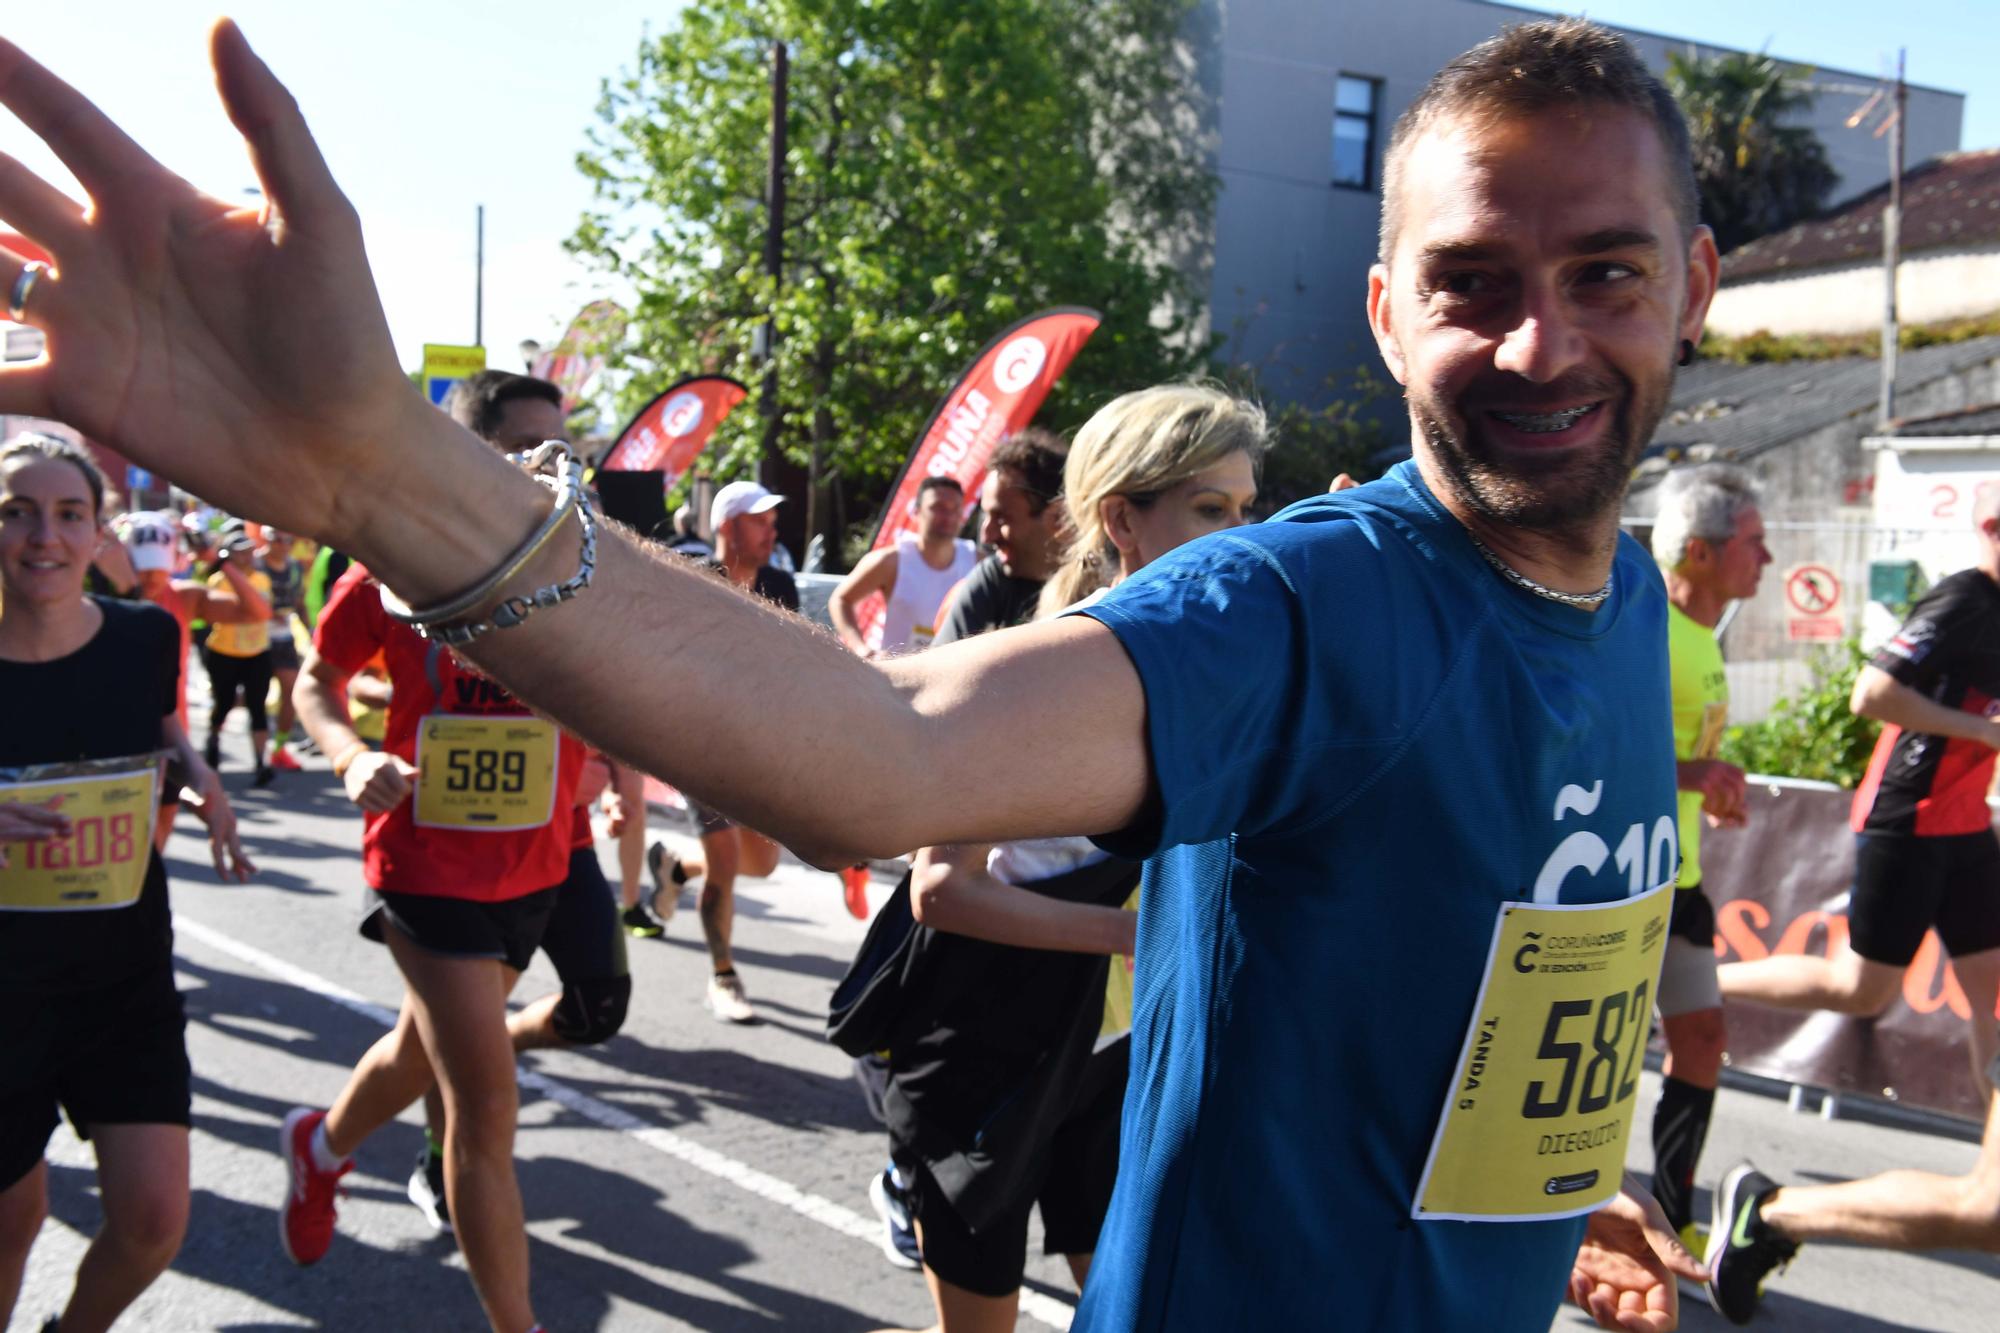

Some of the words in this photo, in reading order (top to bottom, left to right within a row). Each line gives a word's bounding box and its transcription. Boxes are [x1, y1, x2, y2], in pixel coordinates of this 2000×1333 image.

[447, 750, 526, 792] 589
[1464, 1015, 1500, 1092] TANDA
[1521, 979, 1648, 1120] 582
[1536, 1119, 1621, 1156] DIEGUITO
